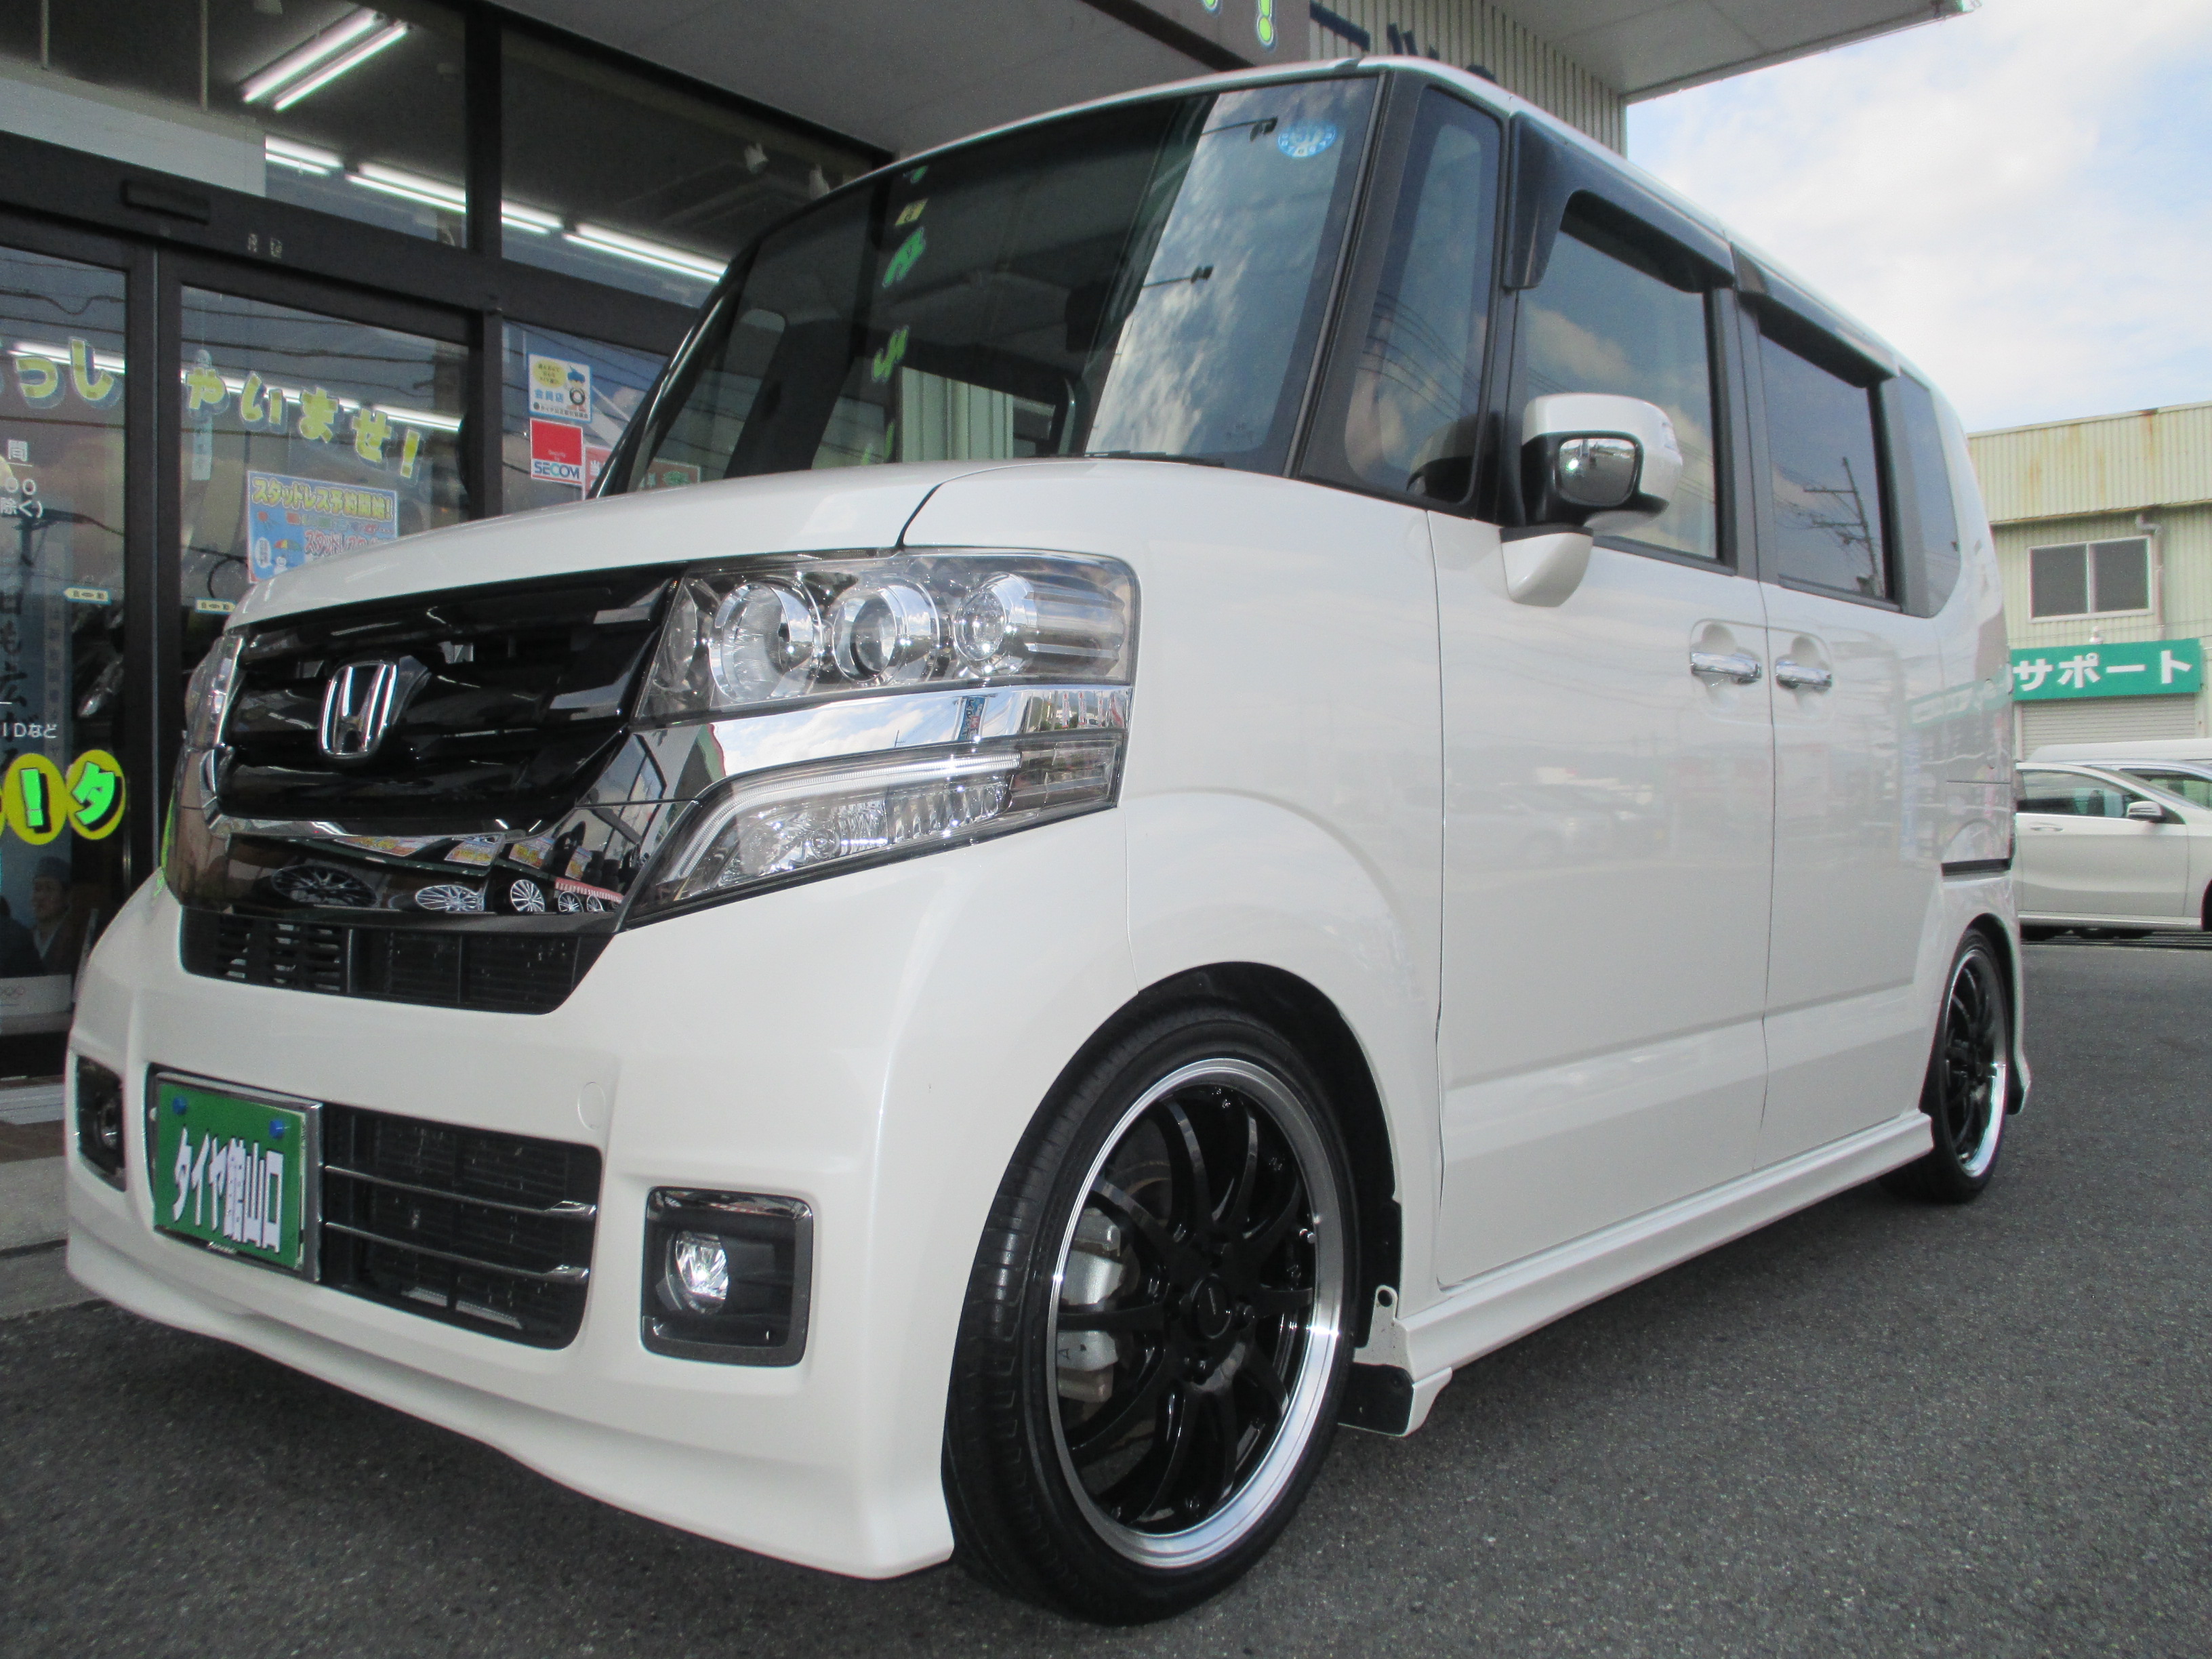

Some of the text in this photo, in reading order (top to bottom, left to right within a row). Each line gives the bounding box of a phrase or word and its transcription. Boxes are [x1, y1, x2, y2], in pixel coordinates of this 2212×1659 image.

[534, 460, 580, 480] SECOM
[2013, 650, 2193, 691] サポート
[171, 1124, 285, 1254] タイヤ館山口
